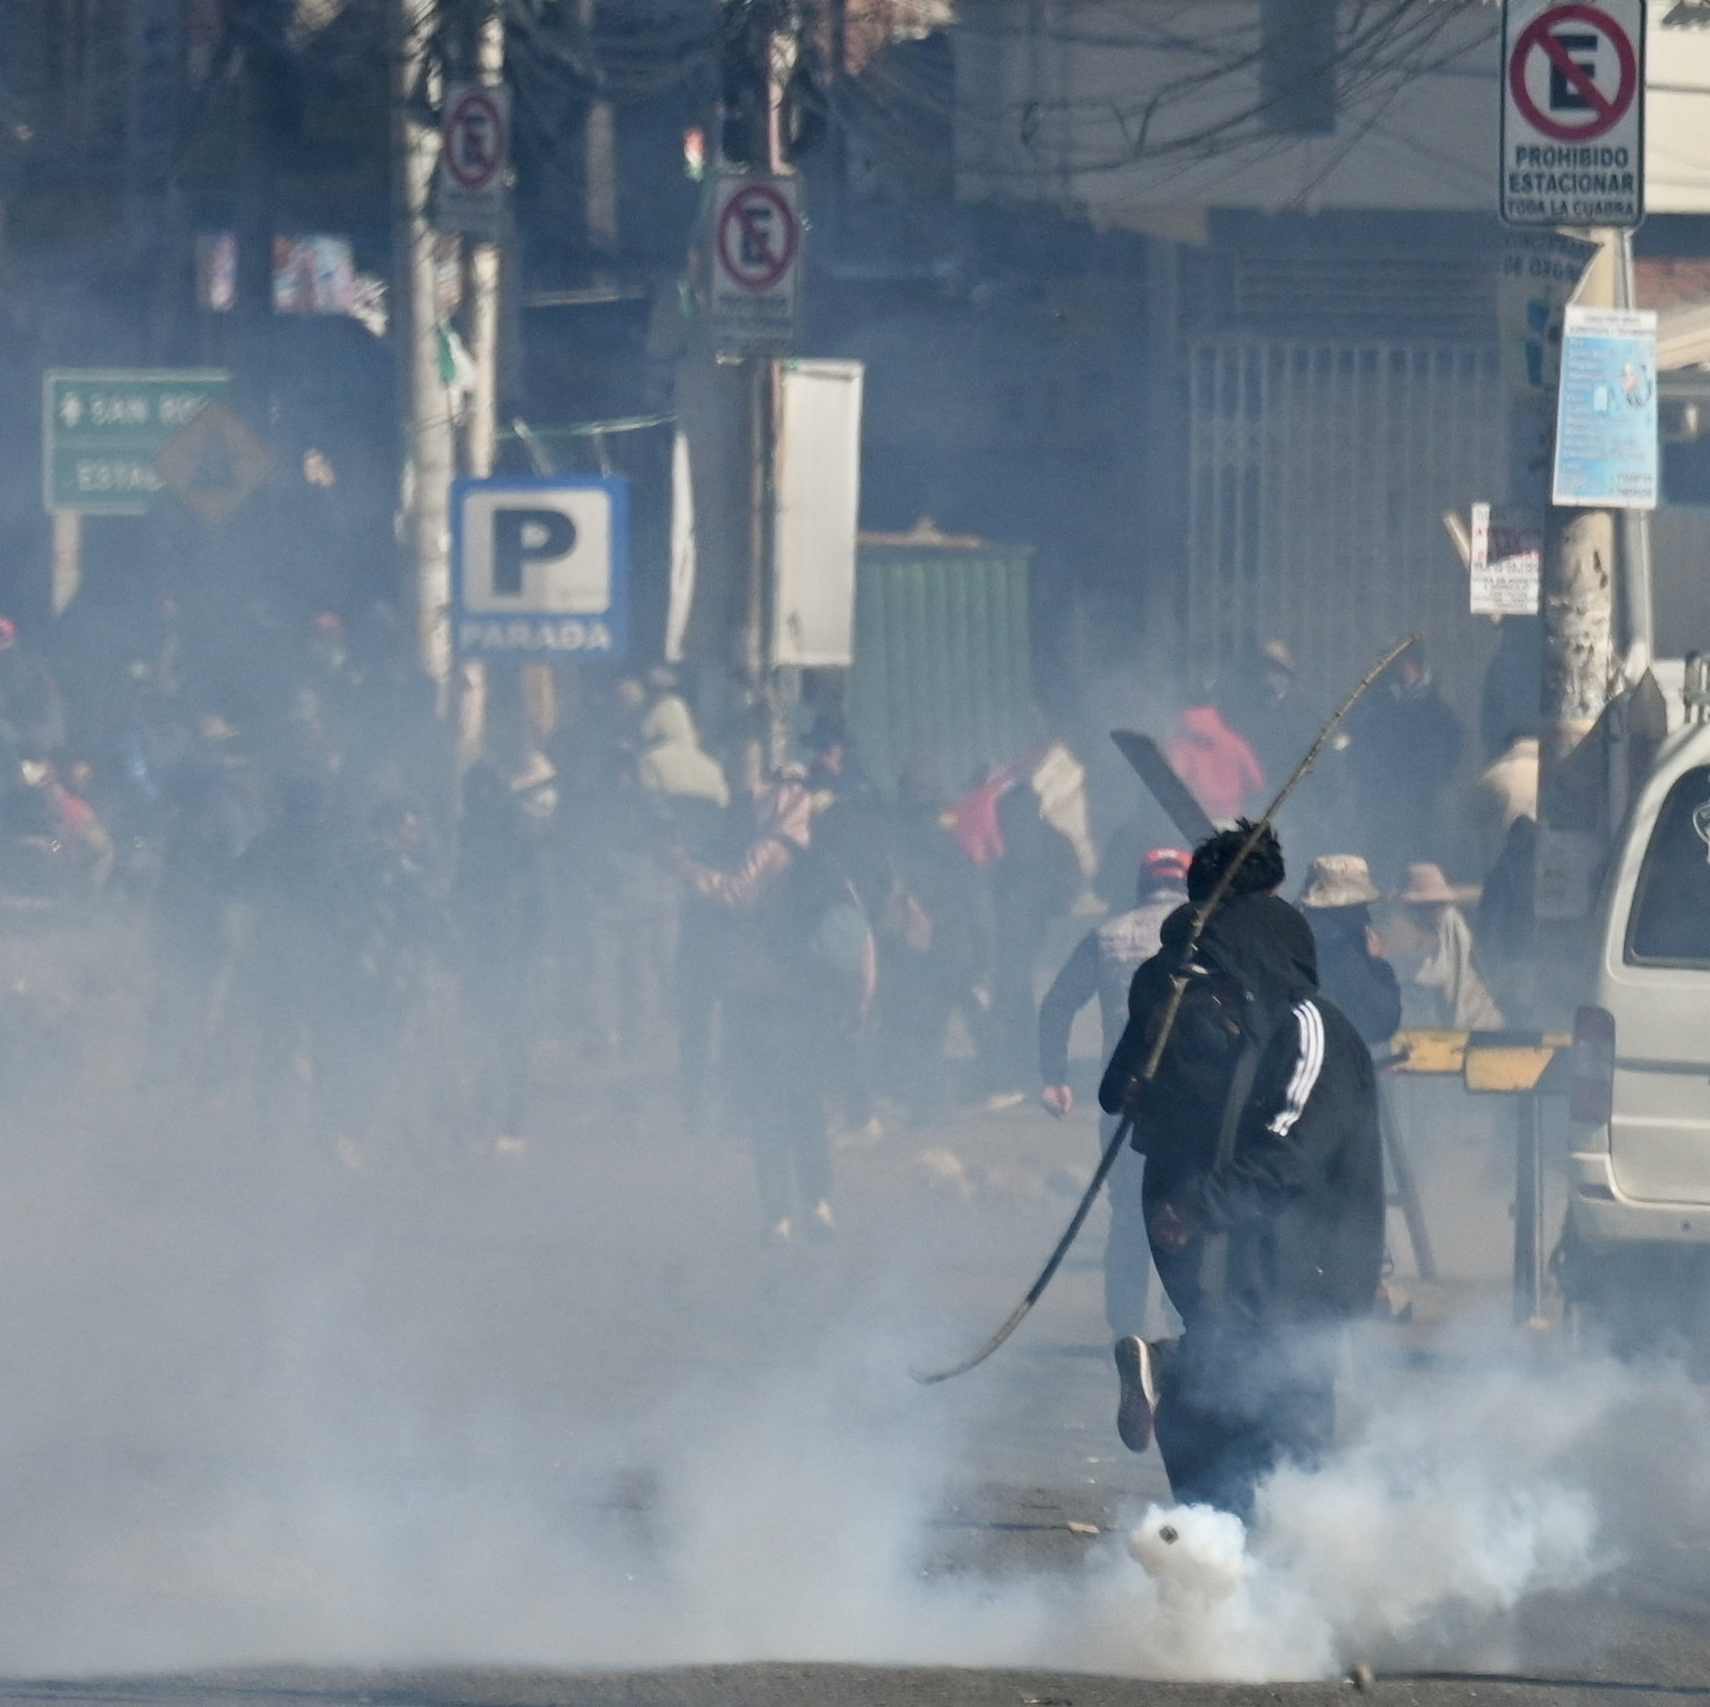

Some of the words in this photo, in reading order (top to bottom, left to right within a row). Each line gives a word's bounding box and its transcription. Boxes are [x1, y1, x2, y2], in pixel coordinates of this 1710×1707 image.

[1548, 34, 1599, 111] E
[1515, 147, 1629, 169] PROHIBIDO
[1508, 173, 1634, 194] ESTACIONAR
[492, 509, 577, 595] P
[460, 621, 612, 651] PARADA
